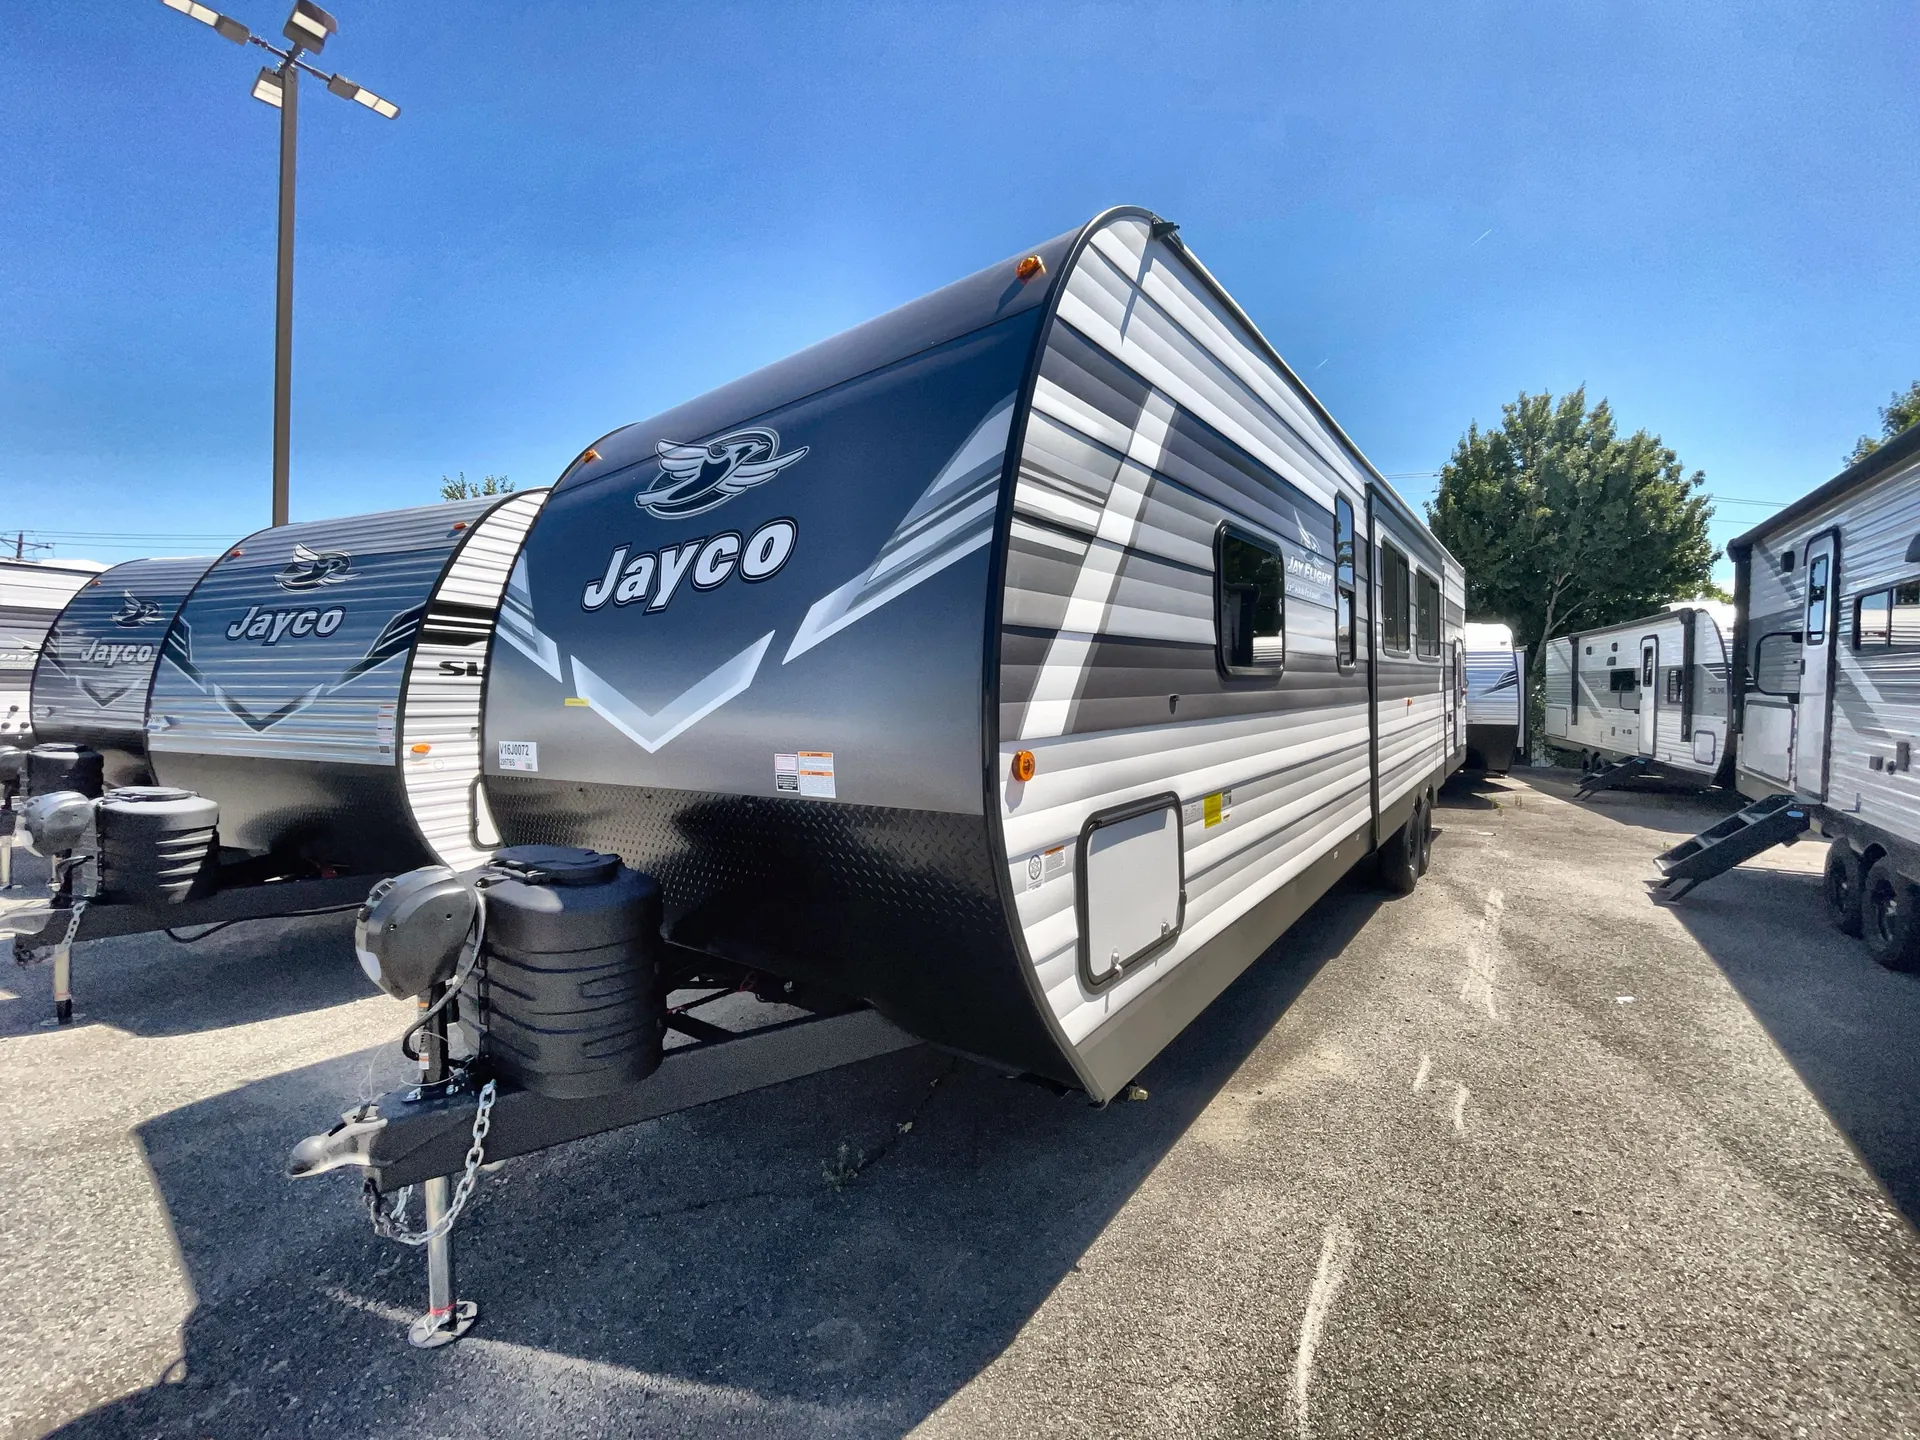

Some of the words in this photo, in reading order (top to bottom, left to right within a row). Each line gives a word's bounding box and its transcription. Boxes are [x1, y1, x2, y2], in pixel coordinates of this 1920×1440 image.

[581, 518, 797, 614] Jayco
[1287, 555, 1303, 575] JAY
[1304, 563, 1331, 587] FLIGHT
[225, 604, 346, 646] Jayco
[80, 638, 154, 668] Jayco
